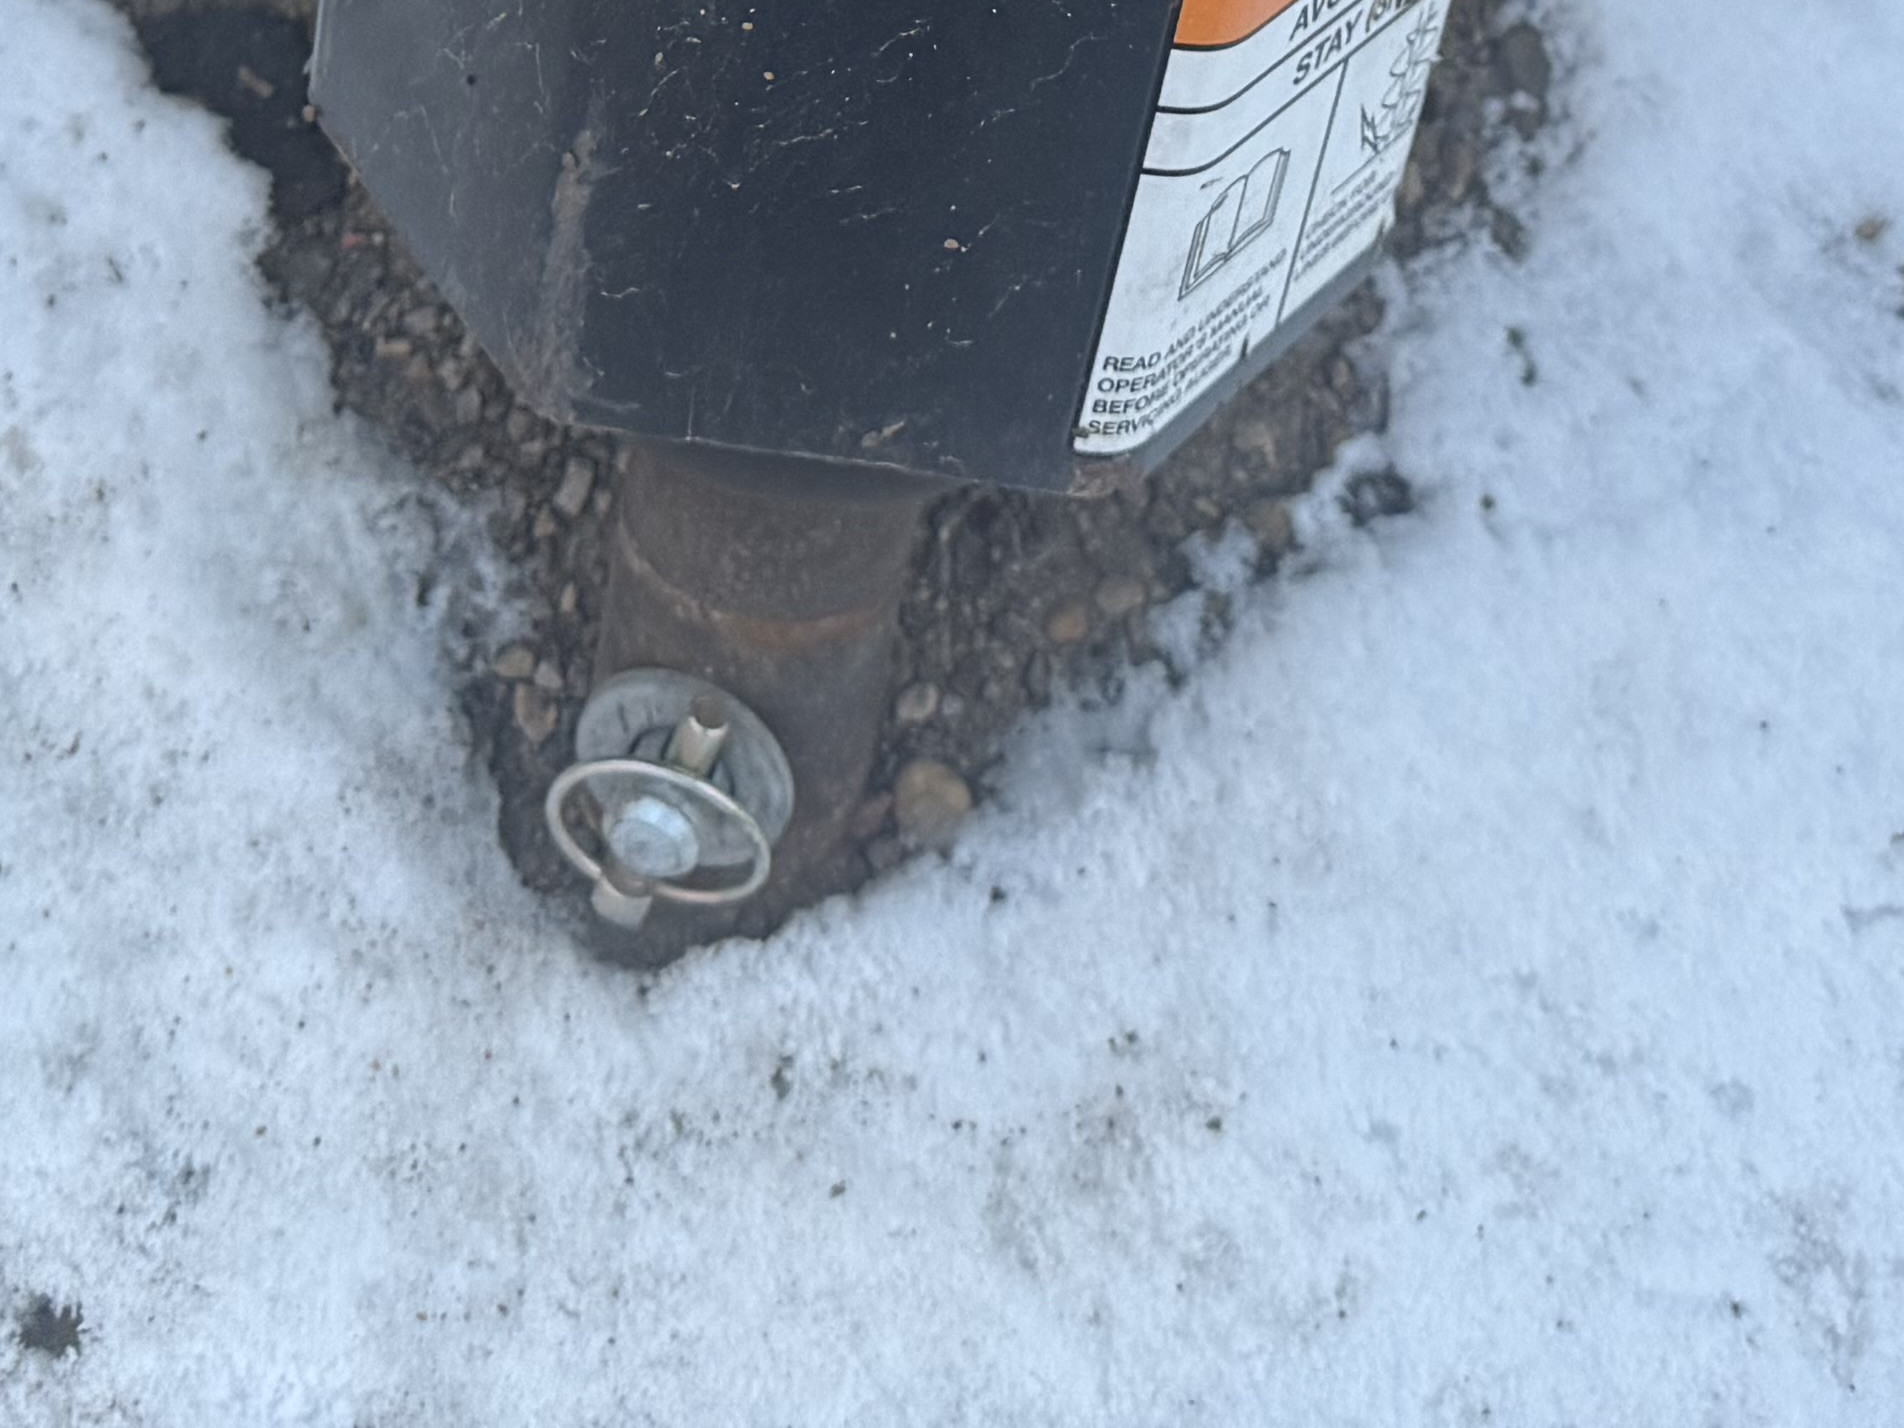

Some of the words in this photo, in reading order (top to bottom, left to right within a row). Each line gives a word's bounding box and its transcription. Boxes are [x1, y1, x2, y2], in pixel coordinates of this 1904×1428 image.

[1293, 9, 1363, 85] STAY
[1102, 351, 1161, 372] READ
[1164, 326, 1196, 359] AND
[1092, 384, 1168, 413] BEFORE
